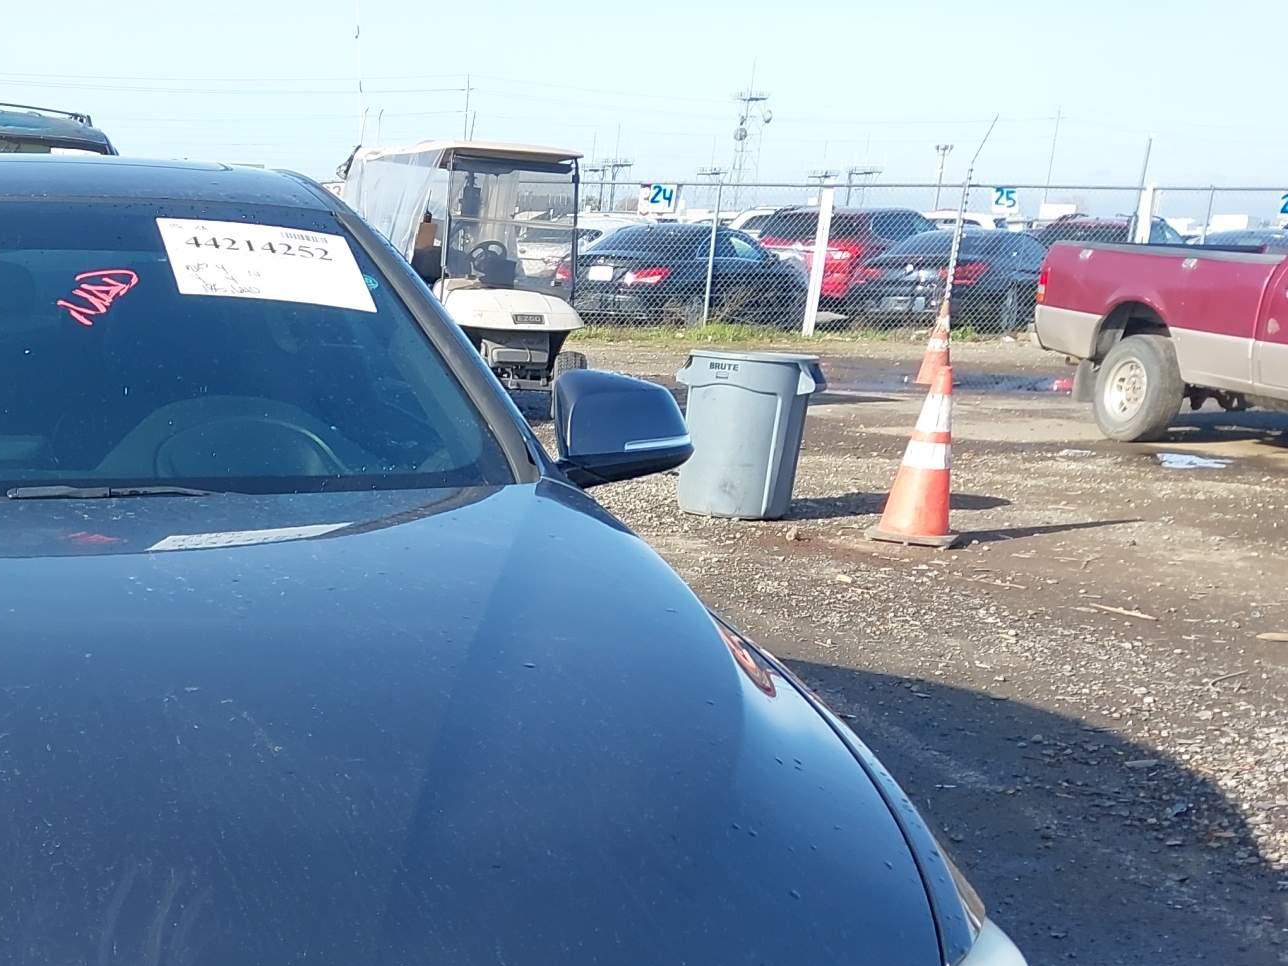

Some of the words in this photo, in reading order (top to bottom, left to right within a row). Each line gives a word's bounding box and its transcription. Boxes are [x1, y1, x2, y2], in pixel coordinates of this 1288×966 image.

[650, 185, 674, 208] 24
[994, 187, 1017, 208] 25
[184, 236, 333, 262] 44214252
[709, 361, 740, 372] BRUTE
